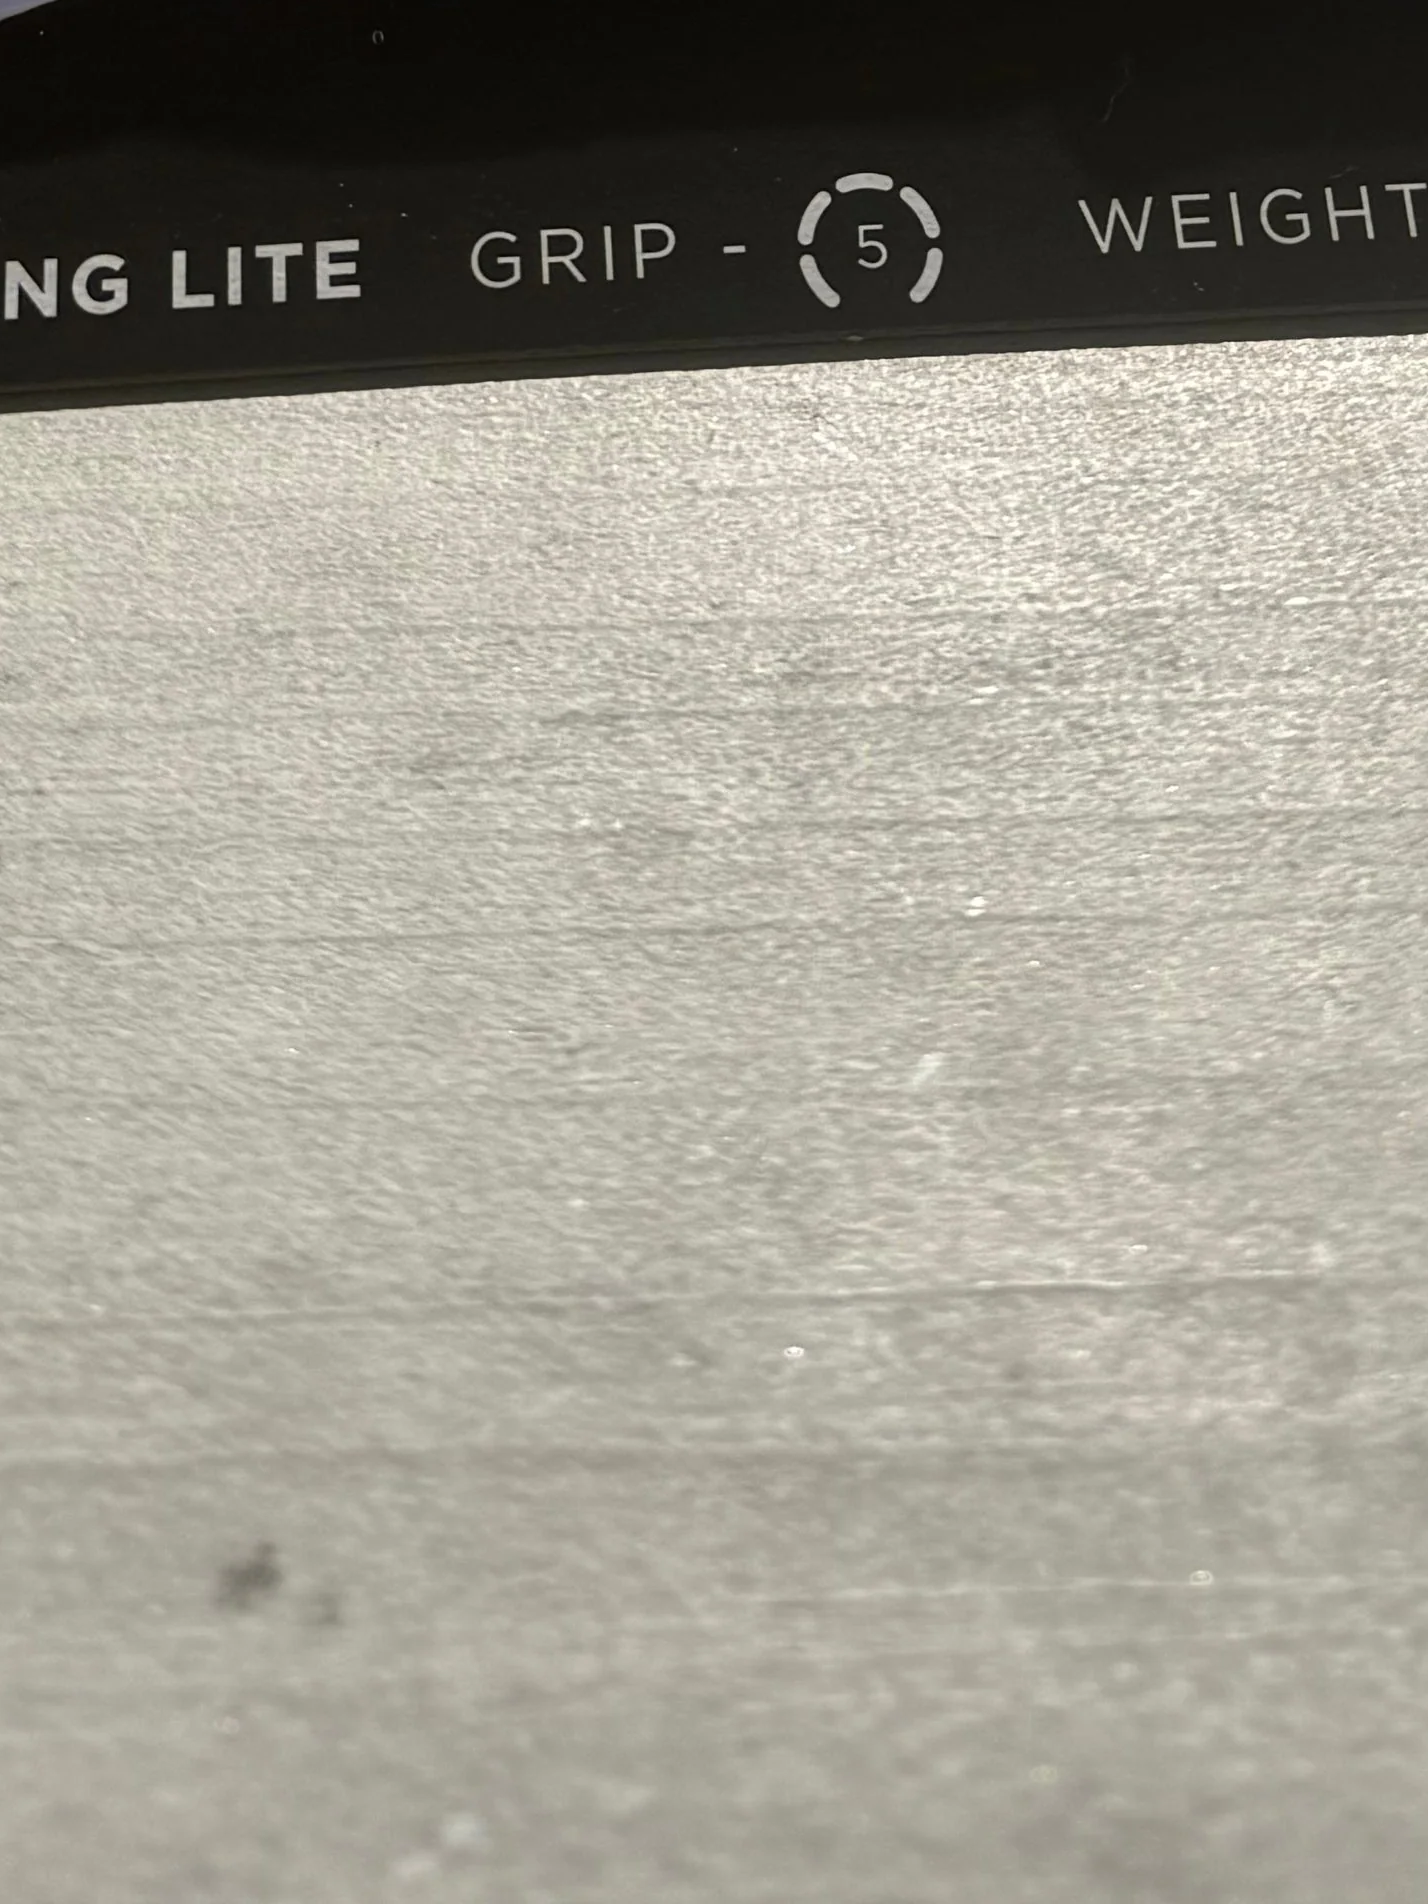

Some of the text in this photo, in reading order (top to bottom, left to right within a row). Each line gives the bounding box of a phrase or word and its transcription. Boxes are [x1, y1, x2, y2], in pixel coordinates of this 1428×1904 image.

[1076, 181, 1428, 255] WEIGHT
[170, 237, 363, 311] LITE
[469, 221, 677, 291] GRIP
[856, 222, 889, 270] 5
